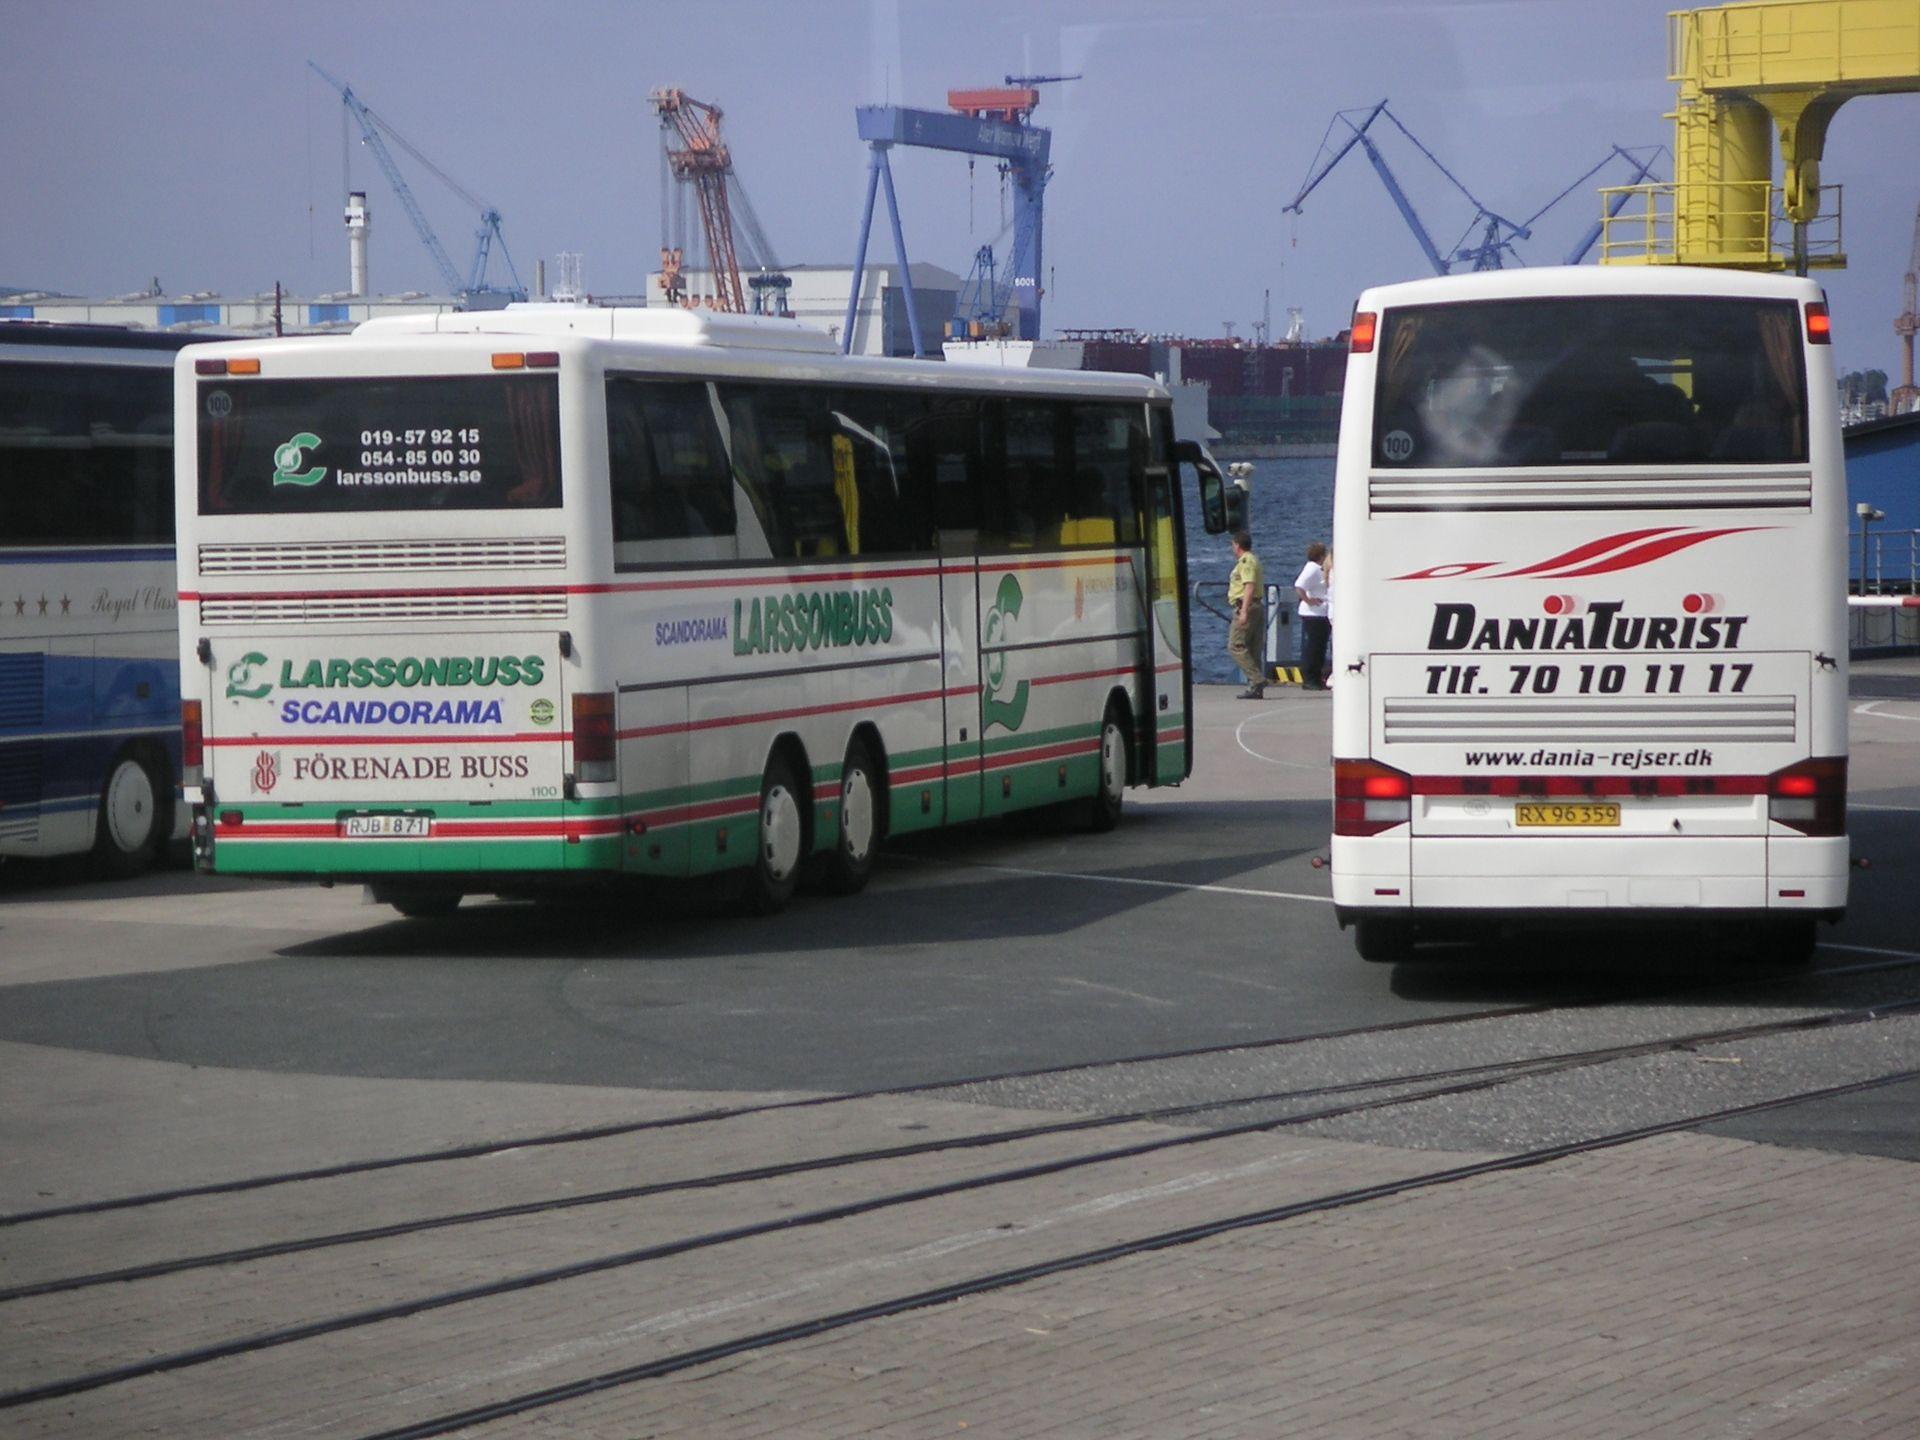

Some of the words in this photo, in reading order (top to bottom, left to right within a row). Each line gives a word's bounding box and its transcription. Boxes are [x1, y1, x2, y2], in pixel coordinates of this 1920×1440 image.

[430, 429, 453, 444] 92
[458, 428, 480, 443] 15
[431, 449, 454, 465] 00
[458, 449, 480, 465] 30
[336, 468, 482, 485] larssonbuss.se
[89, 587, 139, 622] Royal
[655, 617, 727, 646] SCANDORAMA
[733, 587, 893, 656] LARSSONBUSS
[279, 656, 545, 689] LARSSONBUSS
[1426, 664, 1489, 694] Tlf.
[1508, 664, 1561, 694] 70
[1578, 664, 1627, 694] 10
[1644, 664, 1685, 694] 11
[1708, 663, 1754, 693] 17
[280, 700, 502, 725] SCANDORAMA
[294, 753, 452, 780] FÖRENADE
[460, 755, 529, 779] BUSS
[1465, 748, 1713, 769] www.dania-rejser.dk
[531, 786, 558, 797] 1100
[350, 819, 381, 833] RJB
[393, 818, 424, 832] 871
[1519, 807, 1547, 822] RX
